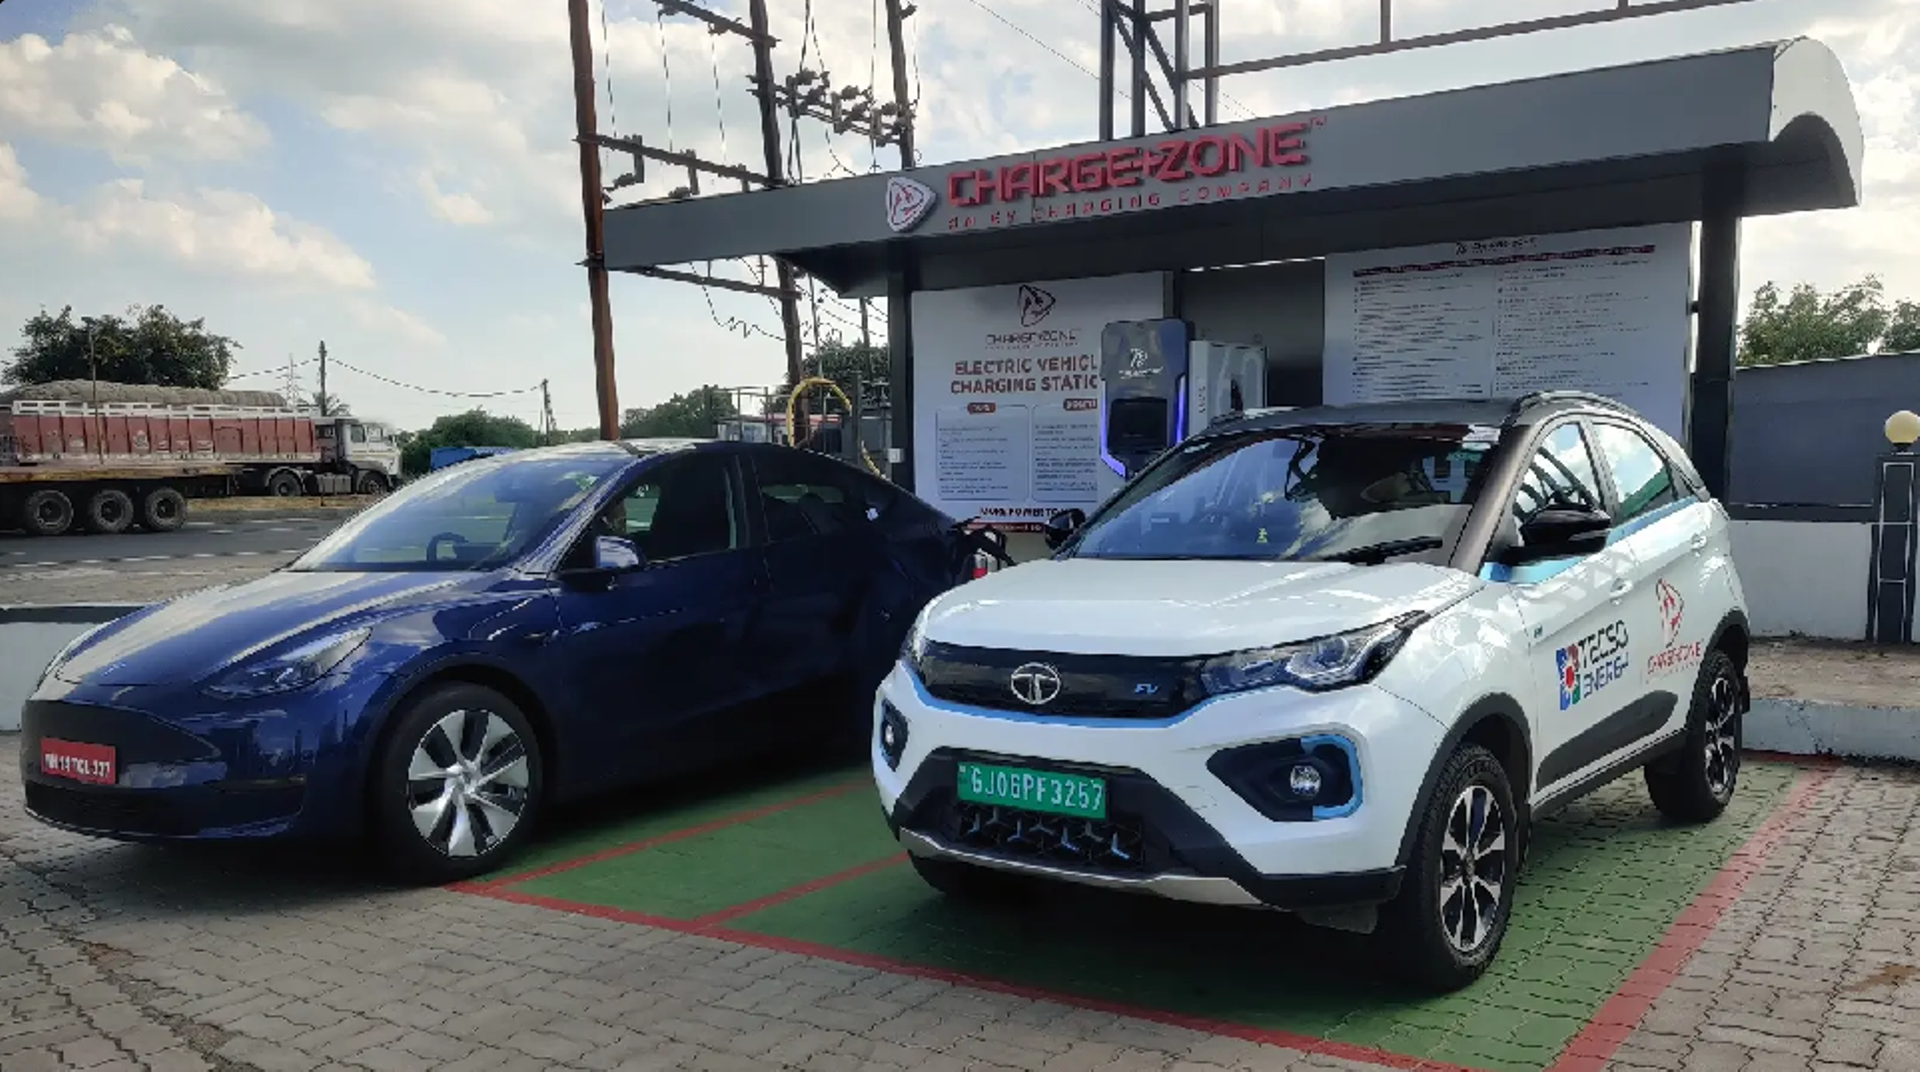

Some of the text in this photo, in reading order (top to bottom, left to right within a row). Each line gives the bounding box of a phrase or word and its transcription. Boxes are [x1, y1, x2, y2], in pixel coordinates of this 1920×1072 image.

[991, 210, 1016, 225] EV
[1033, 192, 1160, 220] CHARGING
[1179, 173, 1312, 203] COMPANY
[955, 354, 1098, 375] ELECTRIC VEHICL
[951, 374, 1098, 395] CHARGING STATIO
[1578, 619, 1629, 668] TECSO
